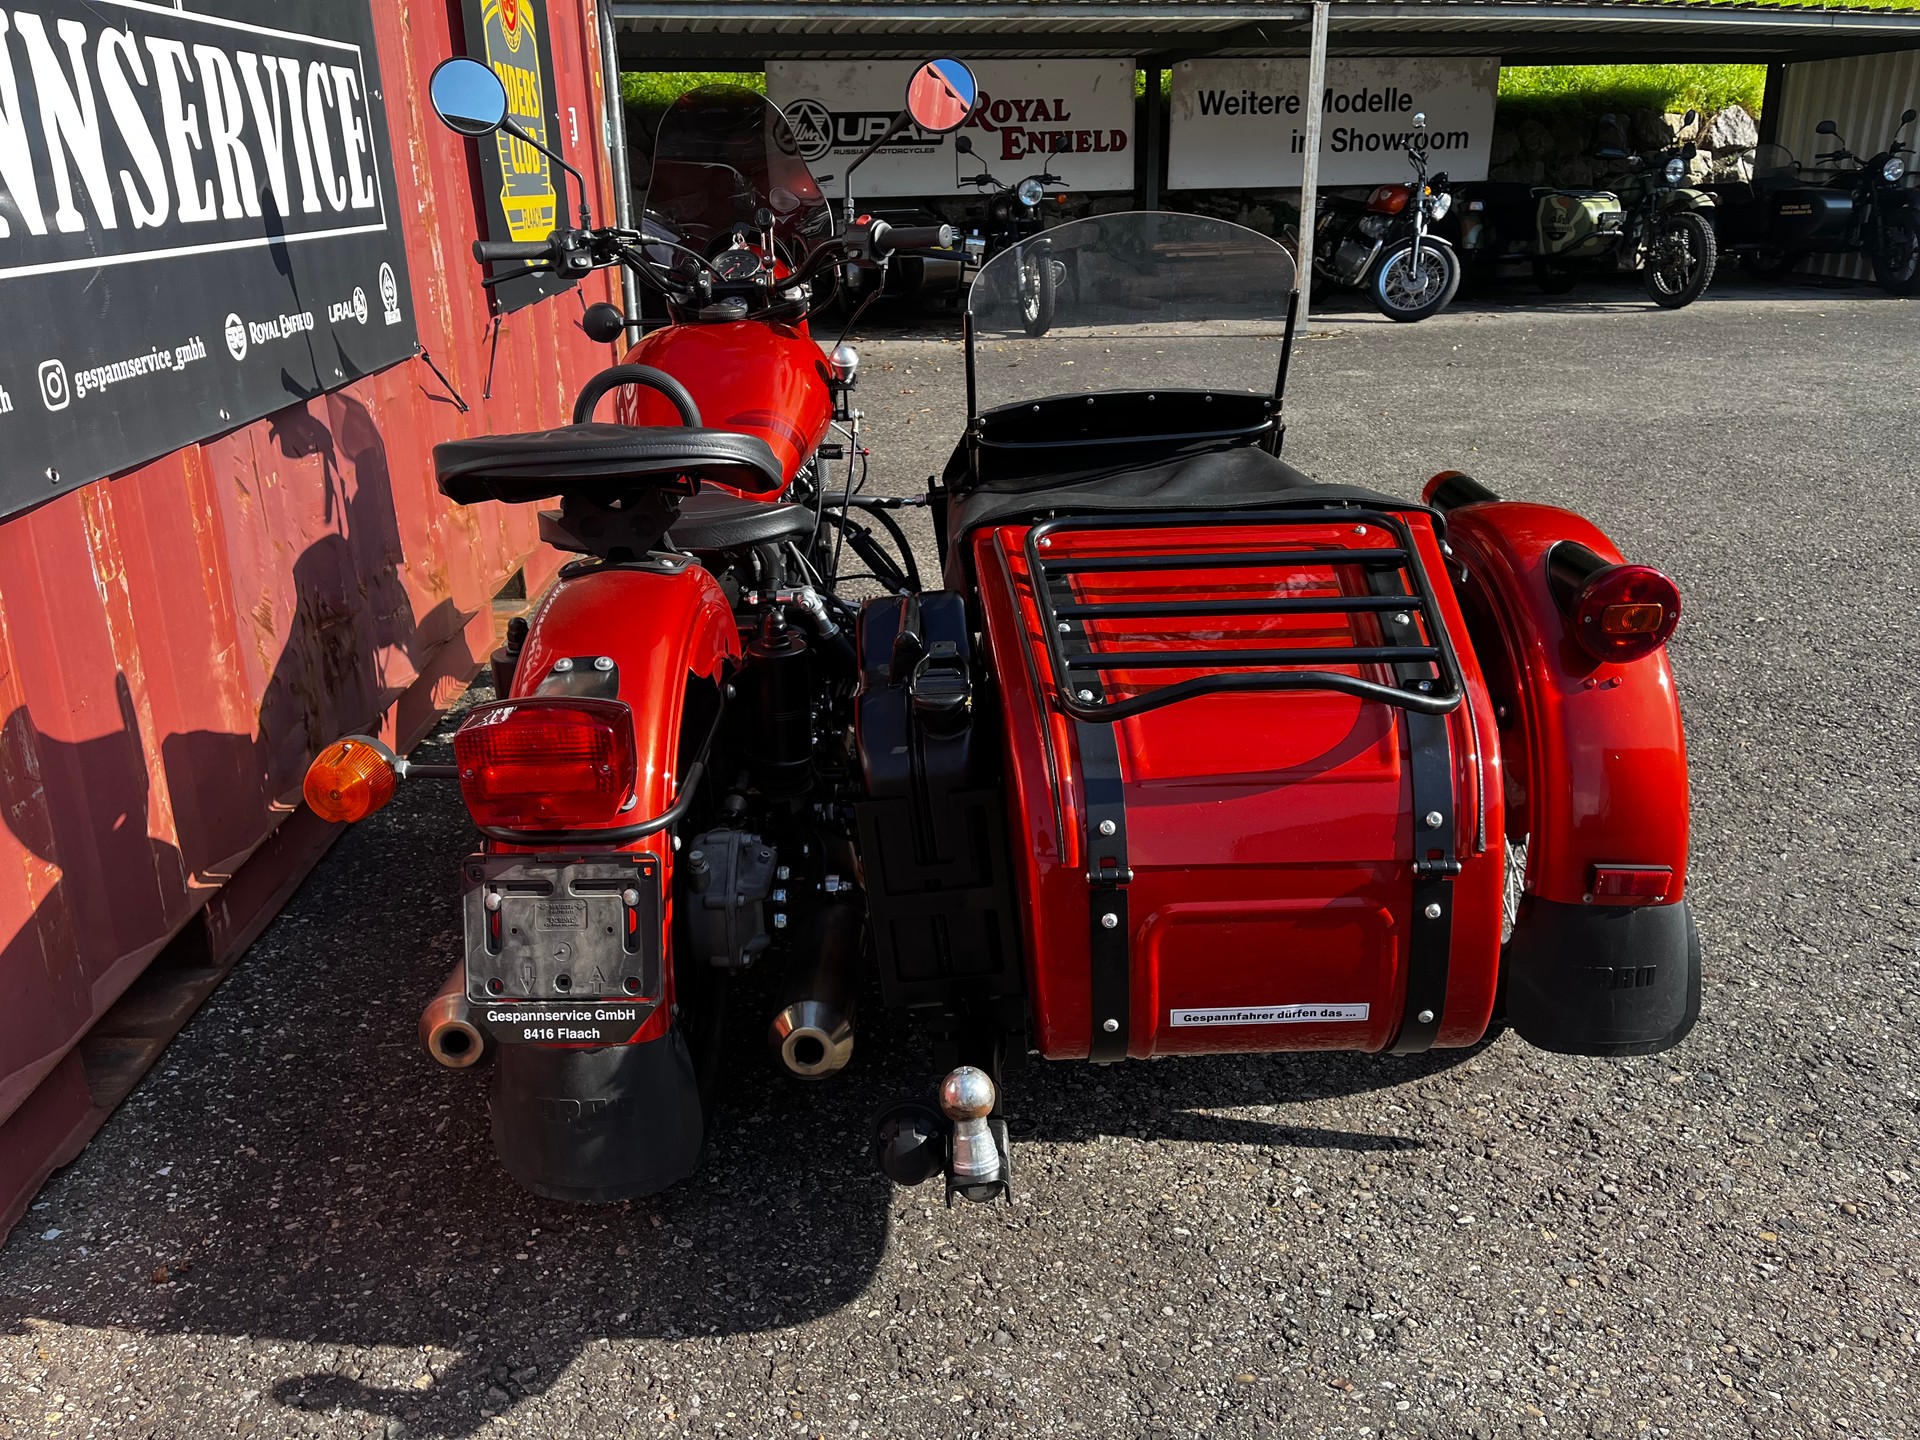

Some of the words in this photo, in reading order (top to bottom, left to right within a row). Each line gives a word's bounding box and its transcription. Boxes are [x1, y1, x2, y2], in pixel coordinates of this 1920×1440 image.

[965, 91, 1070, 132] ROYAL
[1198, 89, 1300, 116] Weitere
[509, 126, 540, 174] CLUB
[875, 147, 935, 155] MOTORCYCLES
[1000, 126, 1127, 160] ENFIELD
[1331, 127, 1469, 153] Showroom
[523, 208, 542, 229] FLAACH
[327, 301, 355, 323] URAL
[248, 320, 281, 344] ROYAL
[279, 311, 314, 338] ENFIELD
[74, 336, 207, 398] gespannservice_gmbh
[486, 1010, 592, 1023] Gespannservice
[595, 1009, 636, 1021] GmbH
[1183, 1012, 1275, 1023] Gespannfahrer
[1277, 1009, 1317, 1020] dürfen
[1320, 1008, 1343, 1018] das
[523, 1028, 554, 1040] 8416
[557, 1028, 601, 1039] Flaach
